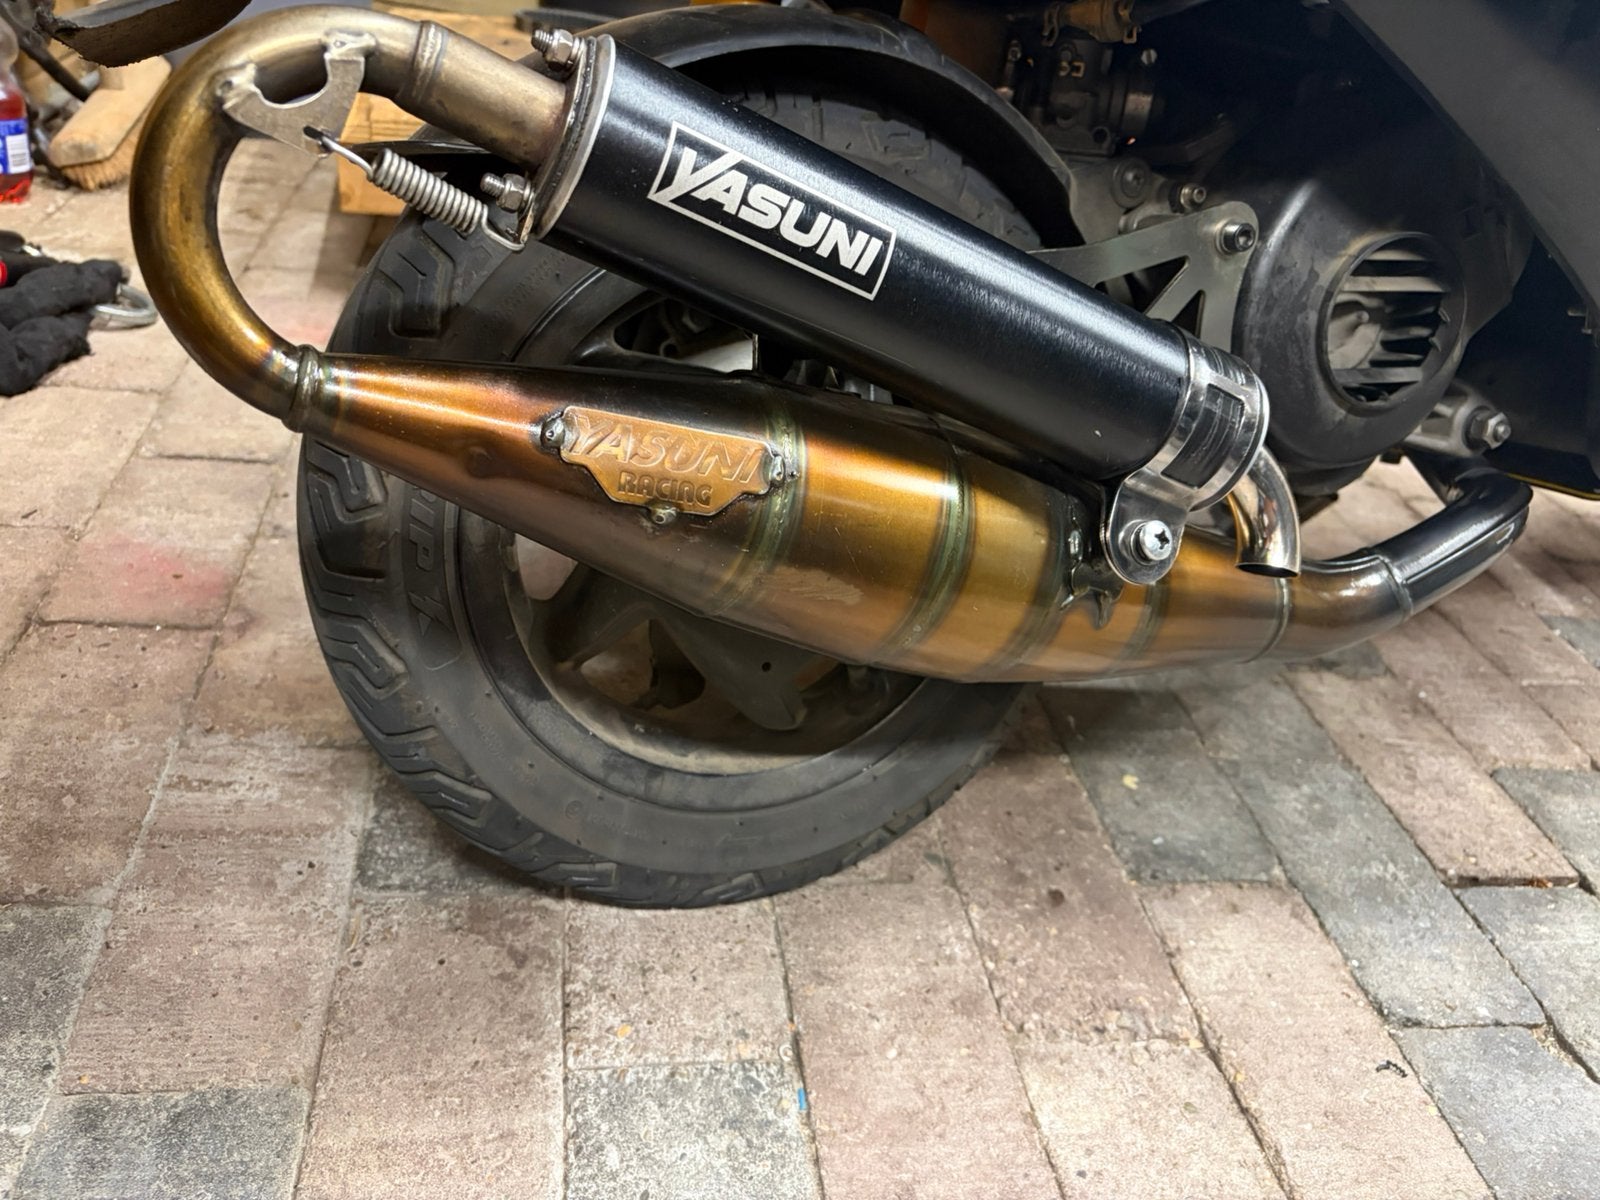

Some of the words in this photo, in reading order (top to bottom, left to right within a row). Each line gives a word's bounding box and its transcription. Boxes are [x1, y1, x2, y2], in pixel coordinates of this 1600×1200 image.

[652, 146, 883, 276] YASUNI
[567, 414, 760, 484] YASUNI
[618, 471, 713, 507] RACING
